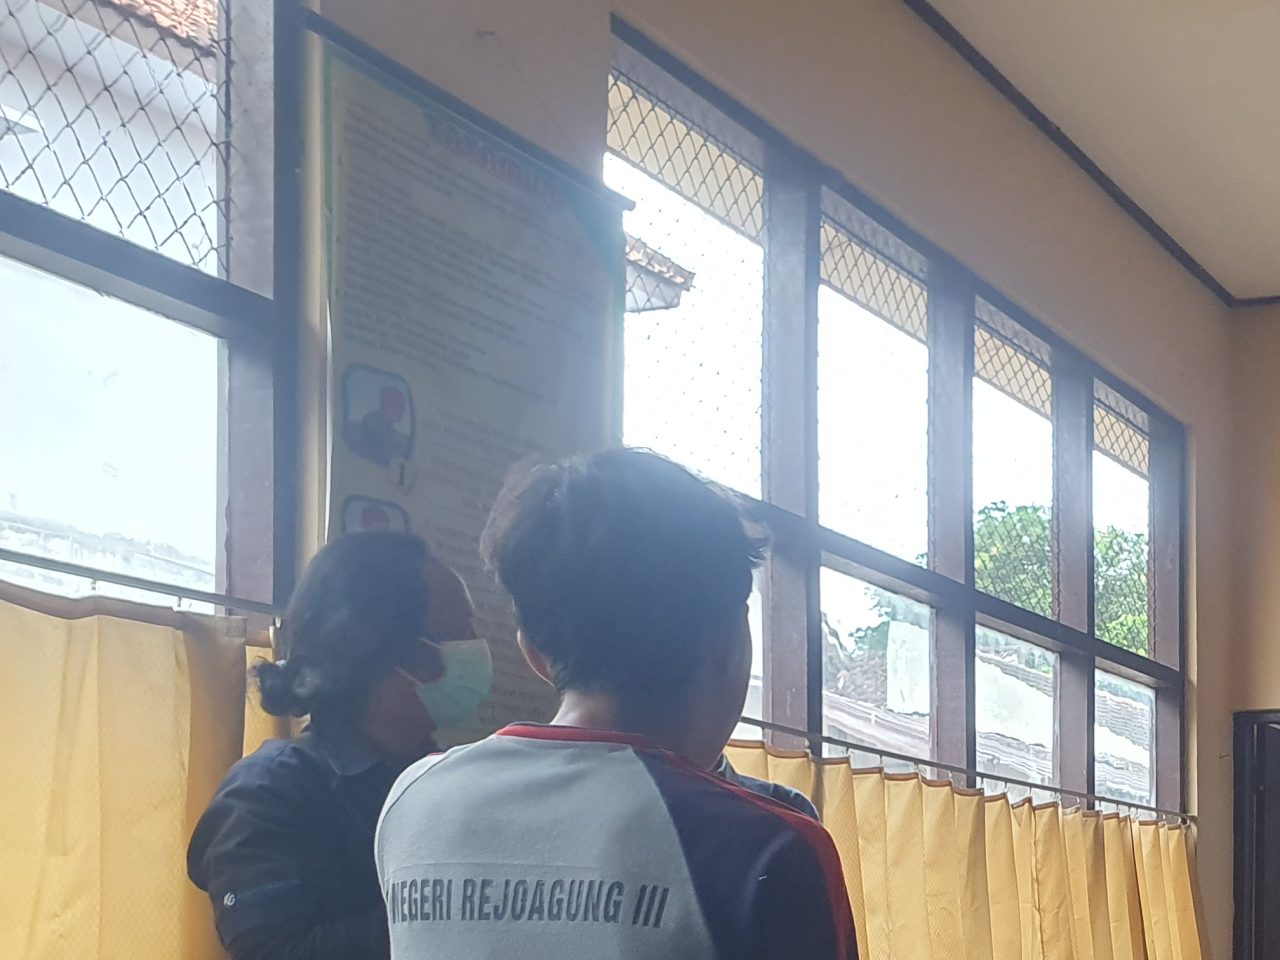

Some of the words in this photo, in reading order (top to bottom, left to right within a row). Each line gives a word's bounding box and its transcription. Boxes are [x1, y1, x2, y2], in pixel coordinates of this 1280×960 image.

[391, 878, 453, 925] NEGERI
[460, 878, 625, 923] REJOAGUNG
[631, 883, 671, 928] III
